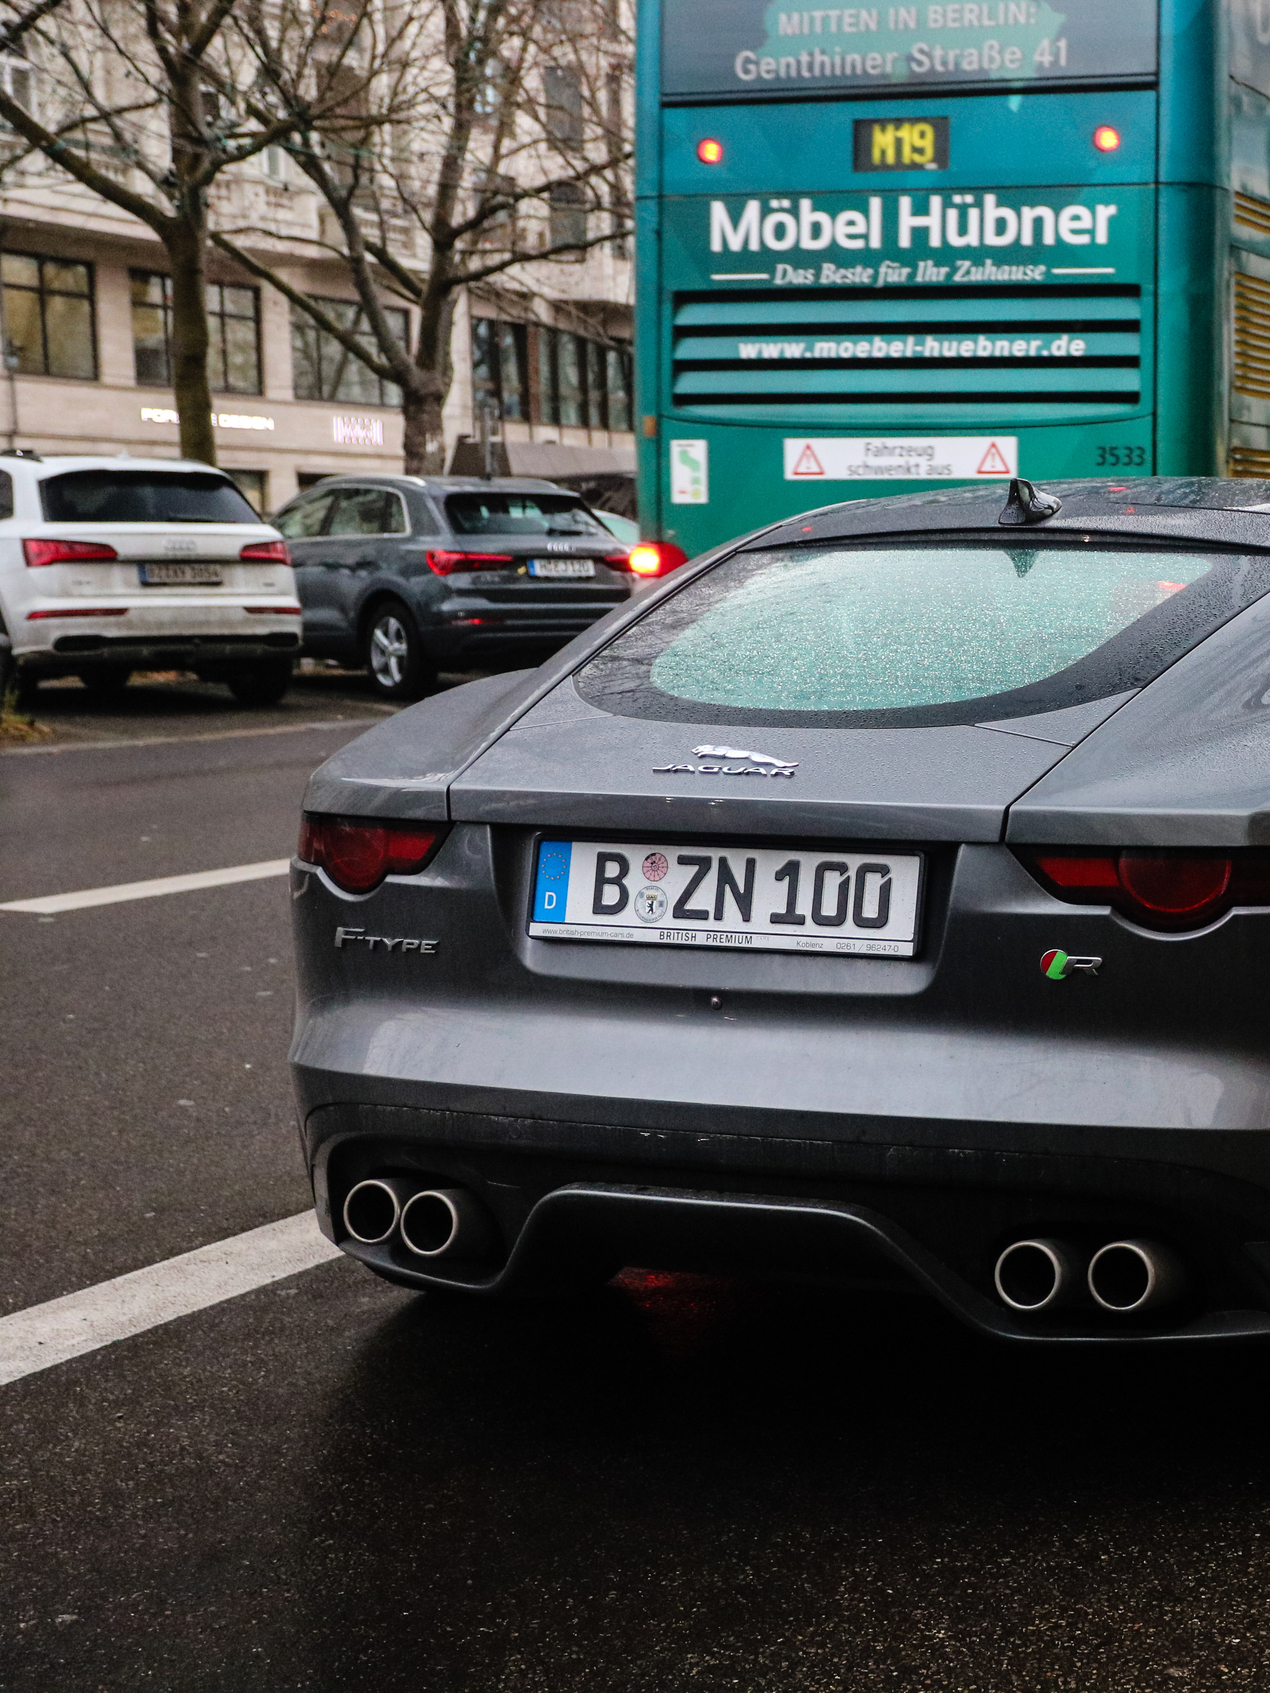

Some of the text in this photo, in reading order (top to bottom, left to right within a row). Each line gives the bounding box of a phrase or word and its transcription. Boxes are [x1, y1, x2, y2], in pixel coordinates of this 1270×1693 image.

[778, 0, 1037, 36] MITTEN IN BERLIN:
[734, 38, 1069, 81] Genthiner Straße 41
[871, 122, 935, 165] M19
[710, 194, 1116, 252] Möbel Hübner
[774, 260, 1046, 287] Das Beste für Ihr Zuhause
[738, 336, 1085, 358] www.moebel-huebner.de
[865, 442, 934, 463] Fahrzeug
[1096, 446, 1145, 467] 3533
[847, 462, 952, 477] schwenkt aus
[652, 763, 794, 777] JAGUAR
[544, 892, 556, 909] D
[592, 852, 630, 915] B
[672, 855, 756, 922] ZN
[769, 860, 890, 929] 100
[334, 927, 440, 954] F-TYPE
[542, 928, 634, 938] www.british-premium-cars.de
[659, 931, 697, 942] BRITISH
[706, 933, 753, 945] PREMIUM
[796, 940, 824, 949] Koblenz
[836, 943, 856, 951] 0261
[866, 944, 899, 953] 96247-0
[1060, 956, 1102, 975] R
